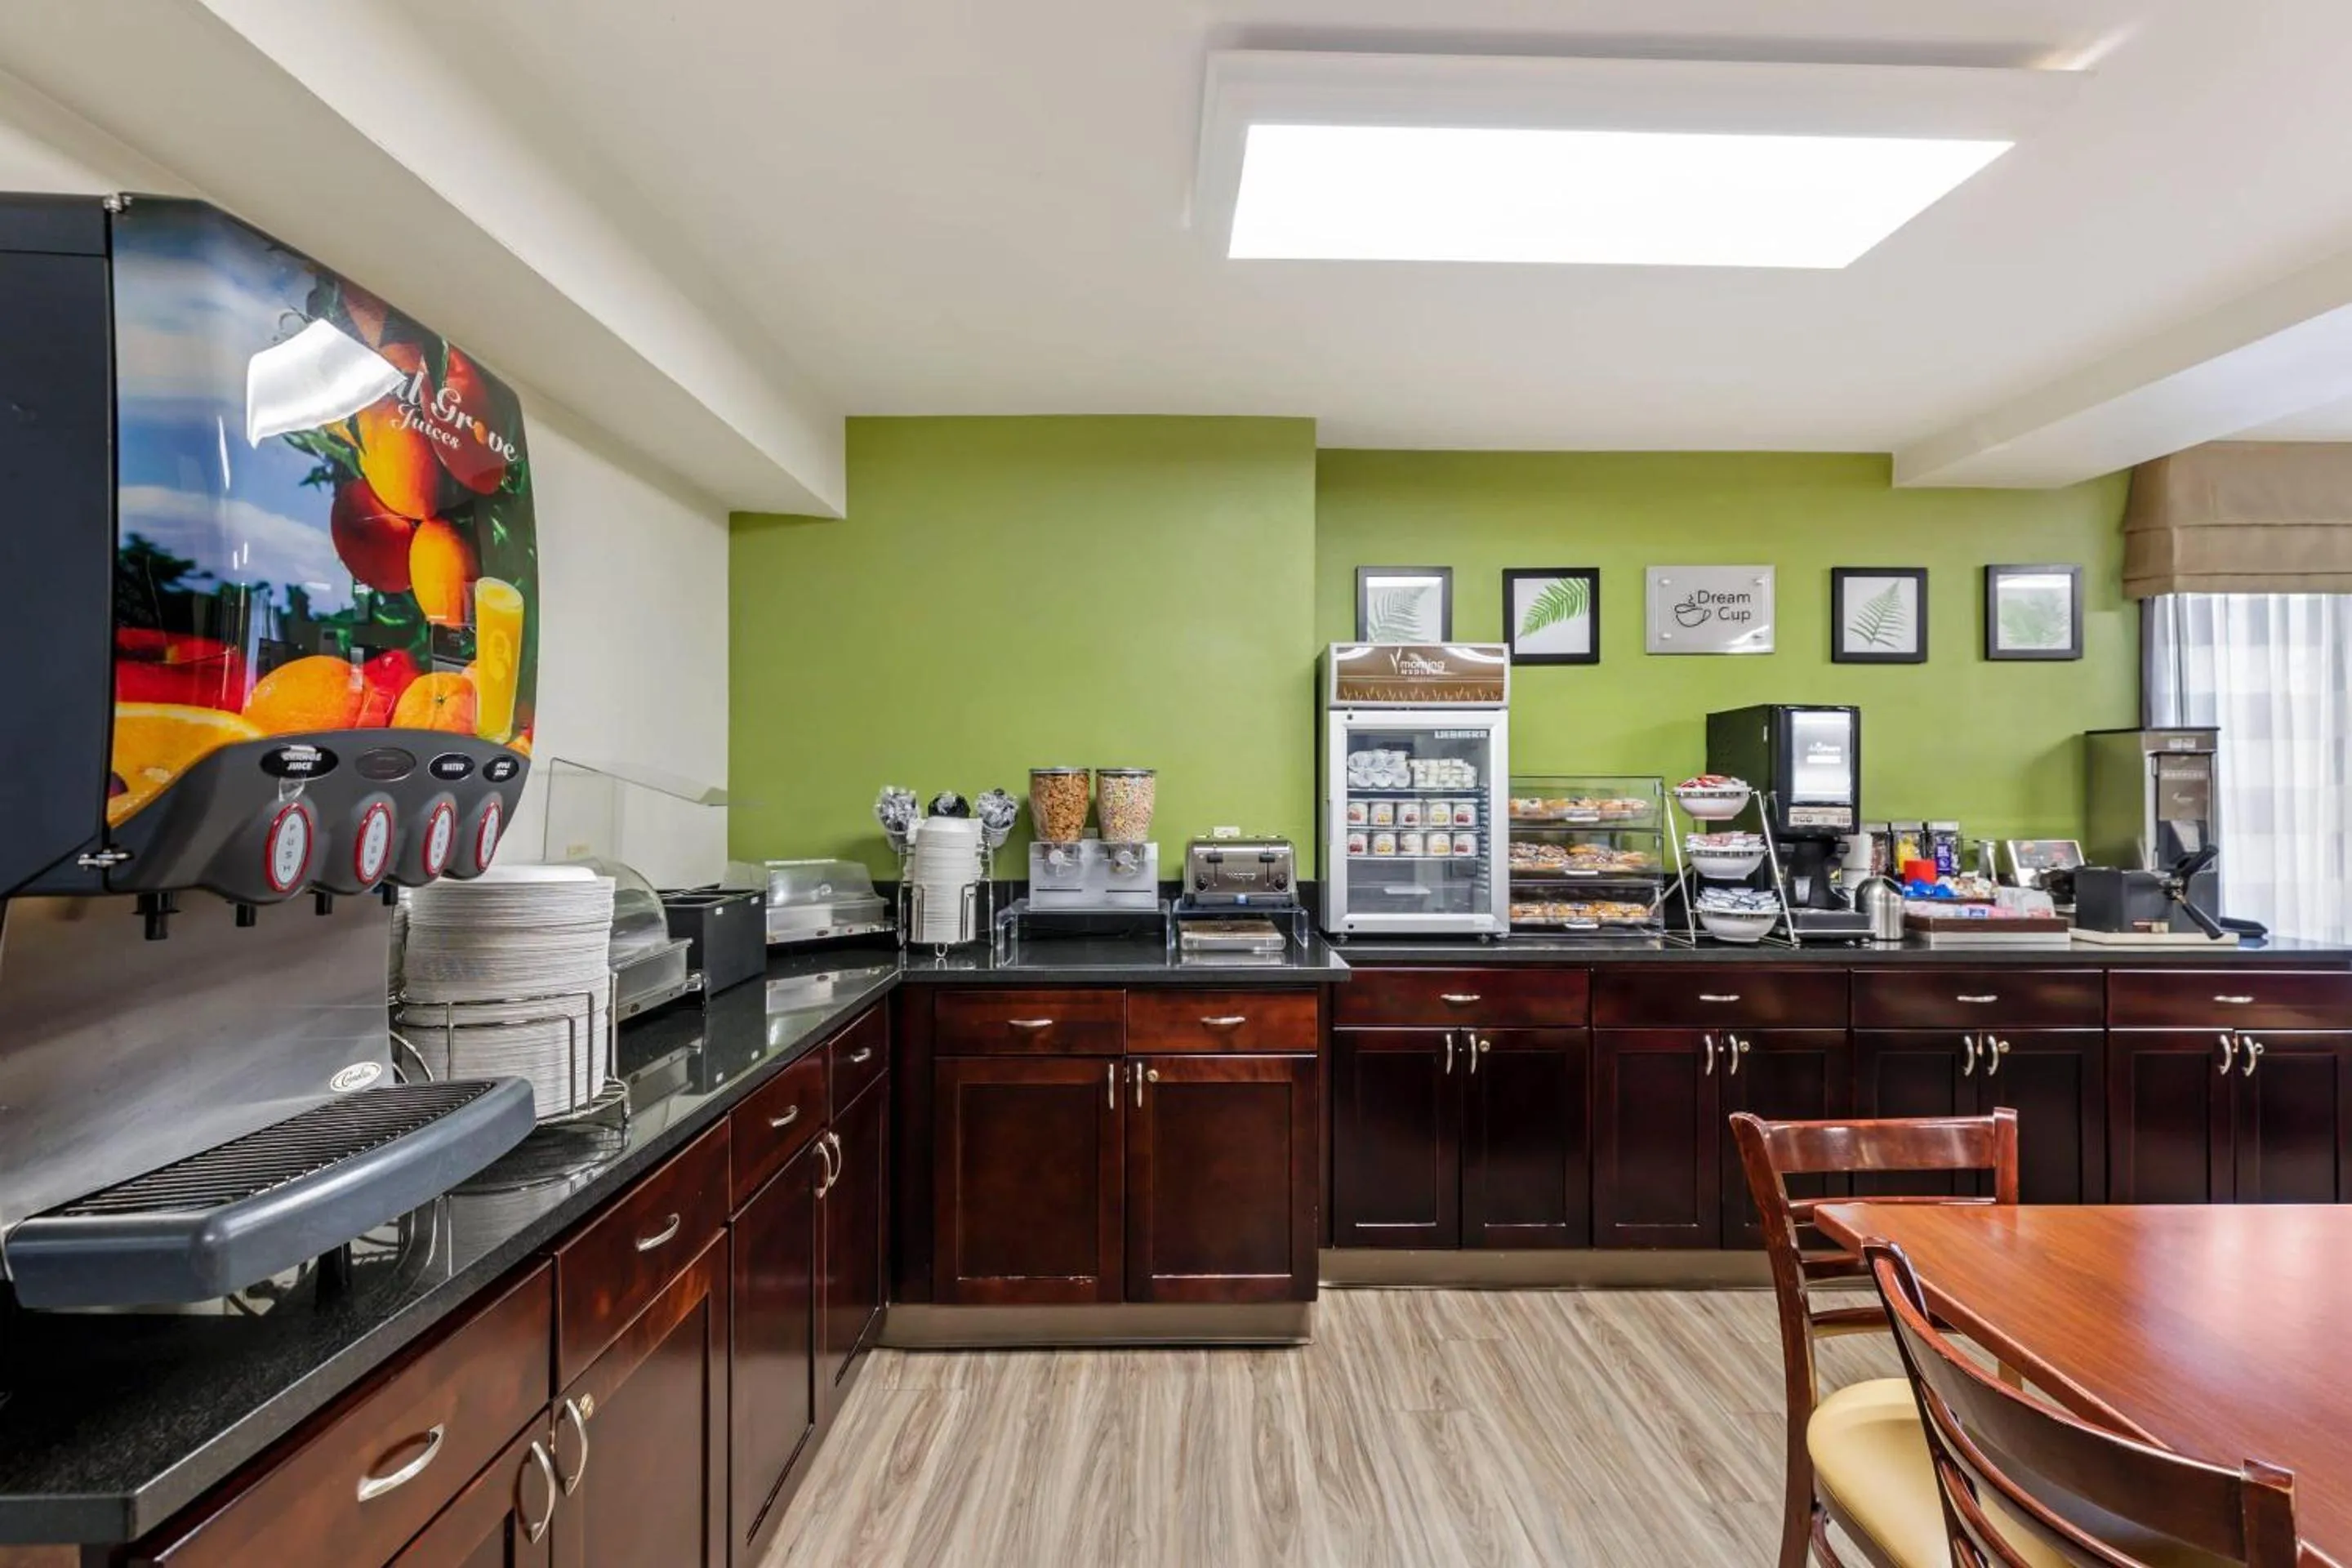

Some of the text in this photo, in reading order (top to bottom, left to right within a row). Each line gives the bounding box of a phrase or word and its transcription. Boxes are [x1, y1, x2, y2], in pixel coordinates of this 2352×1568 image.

[390, 403, 462, 450] Juices
[431, 386, 518, 461] Grove
[1697, 590, 1751, 604] Dream
[1717, 606, 1752, 624] Cup
[287, 761, 314, 771] JUICE
[442, 763, 466, 771] WATER
